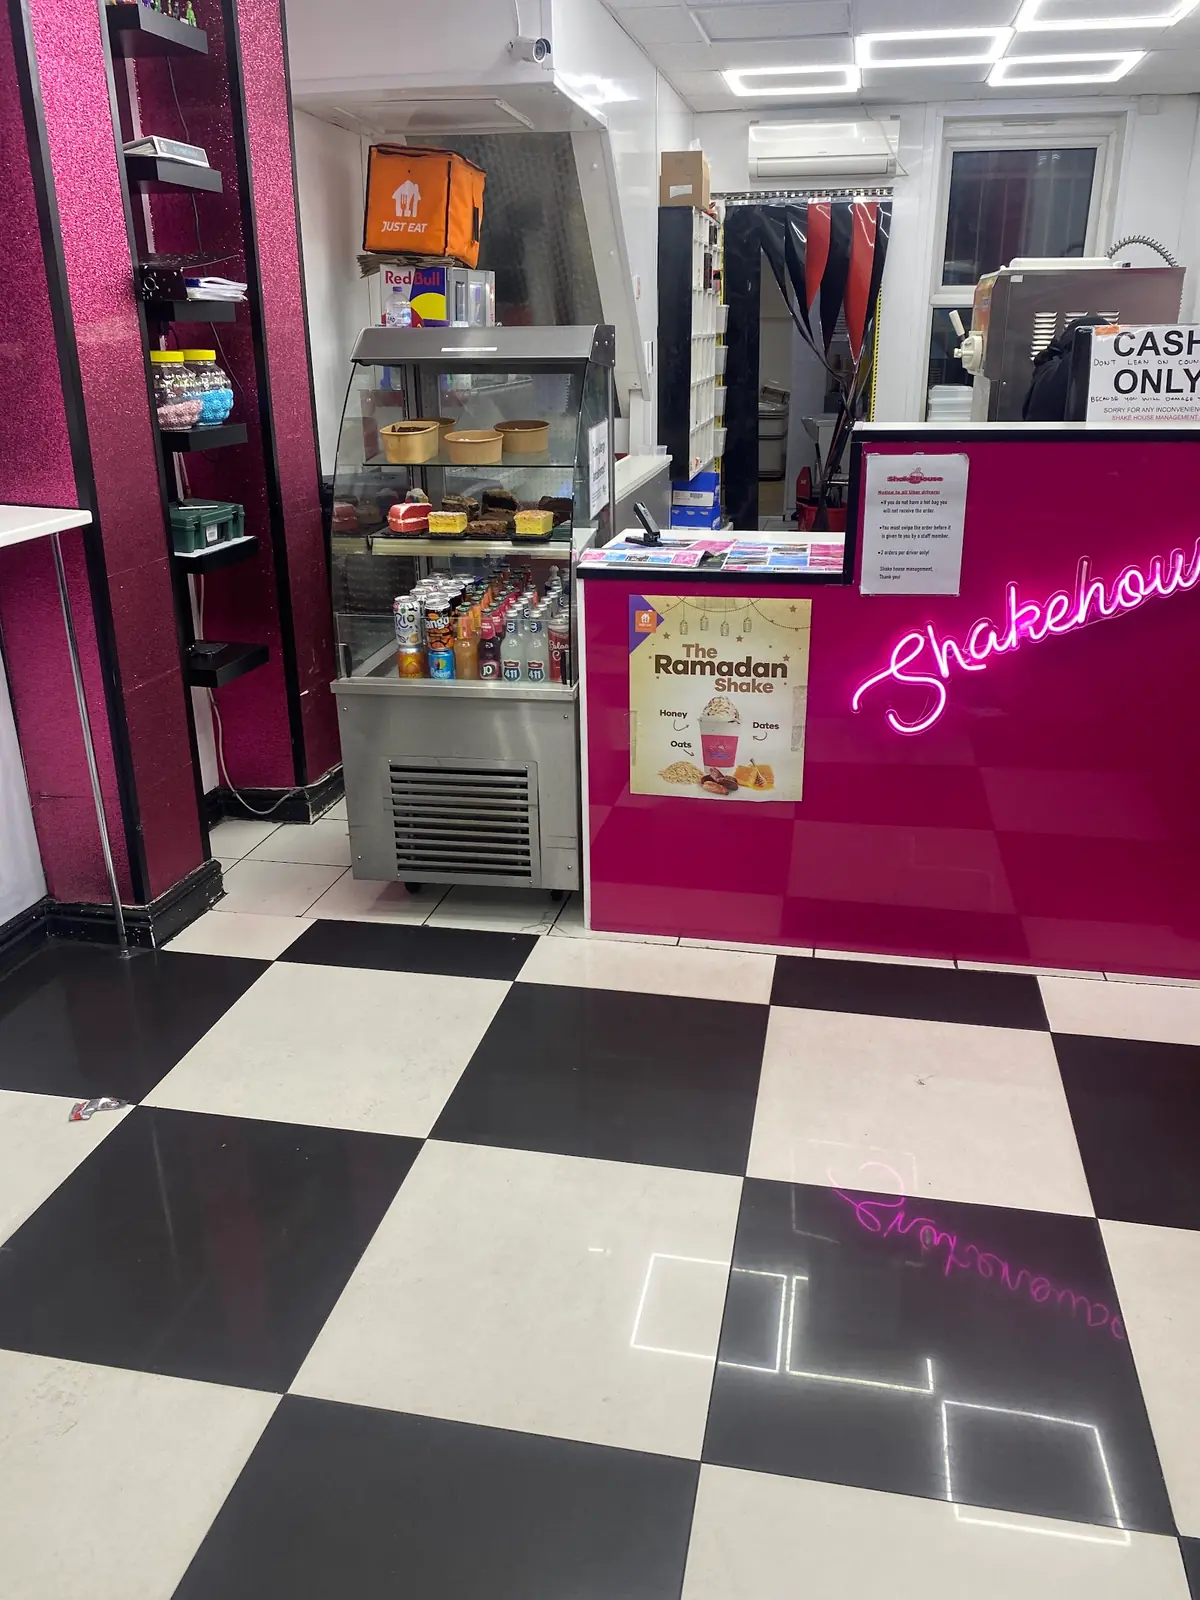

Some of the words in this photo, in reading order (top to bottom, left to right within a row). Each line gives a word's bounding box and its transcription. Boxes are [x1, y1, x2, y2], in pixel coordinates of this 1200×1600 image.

[381, 221, 408, 232] JUST
[408, 223, 428, 232] EAT
[385, 271, 412, 284] Red
[414, 272, 440, 286] Bull
[1114, 330, 1200, 357] CASH
[1114, 368, 1200, 394] ONLY
[425, 615, 450, 629] ango
[850, 538, 1200, 732] Shakehou
[682, 643, 718, 658] The
[505, 669, 517, 678] 411
[654, 654, 788, 678] Ramadan
[714, 678, 774, 693] Shake
[660, 710, 687, 719] Honey
[752, 722, 780, 730] Dates
